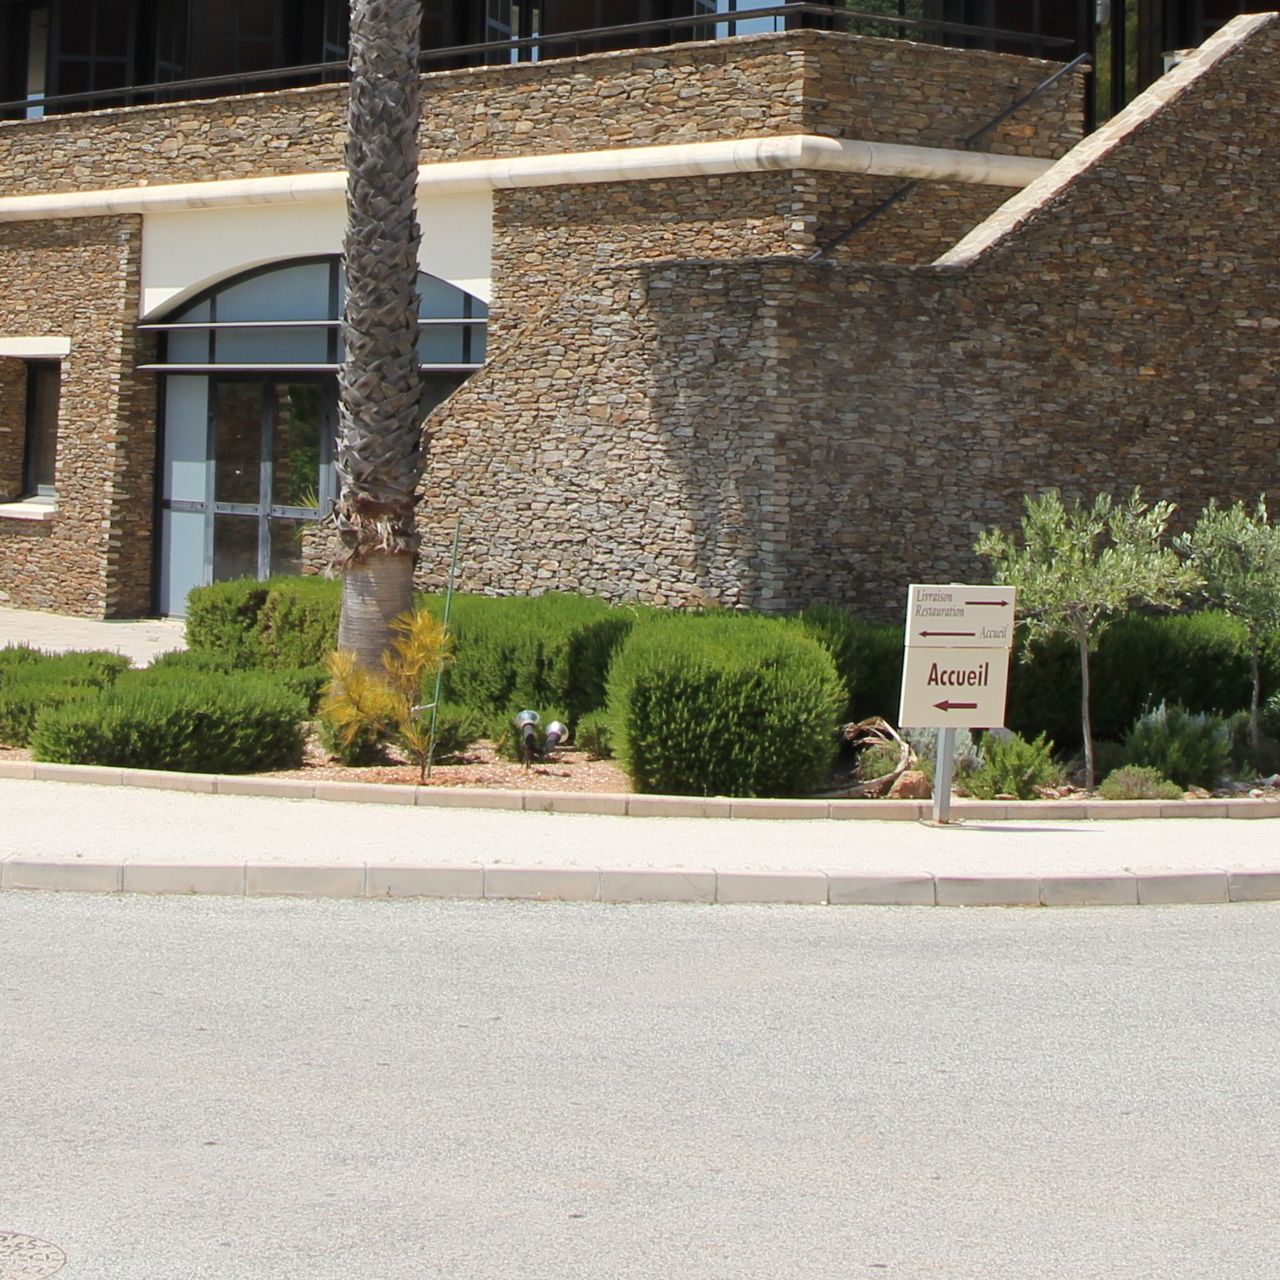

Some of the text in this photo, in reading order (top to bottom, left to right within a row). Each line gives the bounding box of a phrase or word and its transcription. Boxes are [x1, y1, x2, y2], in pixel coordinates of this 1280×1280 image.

[916, 589, 953, 602] Livraison
[915, 605, 965, 617] Restauration
[979, 624, 1009, 639] Accueil
[927, 662, 989, 686] Accueil
